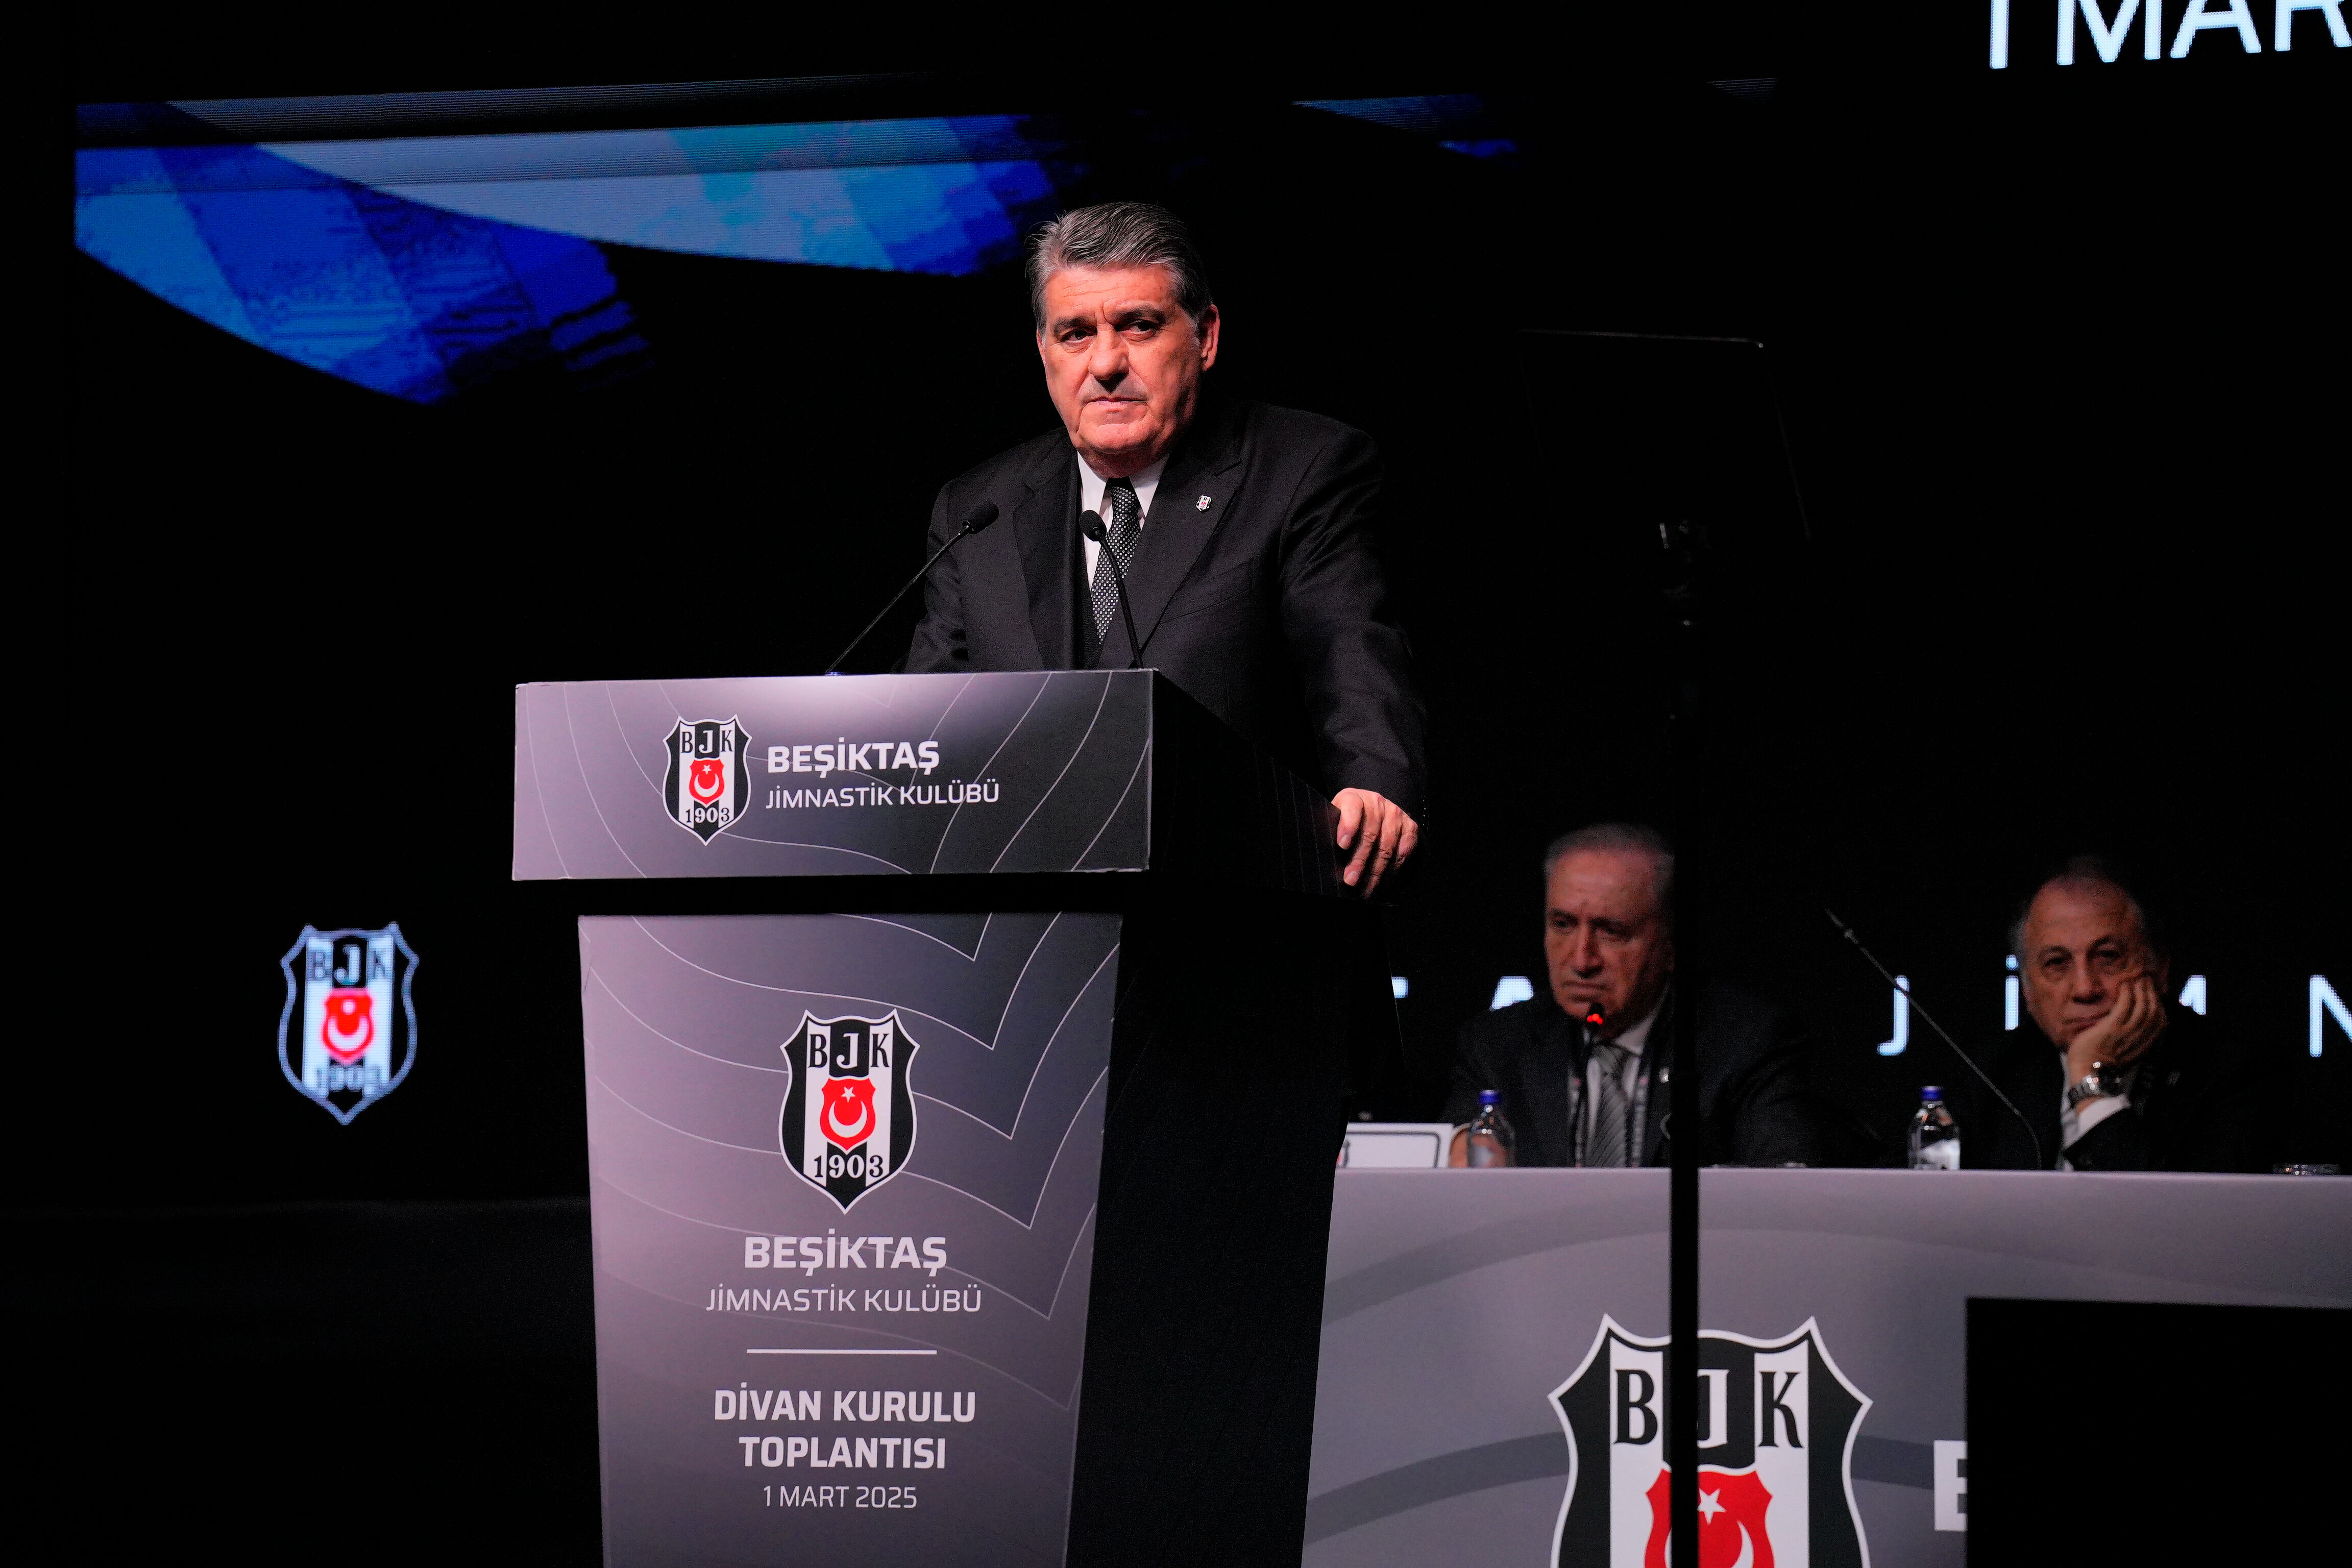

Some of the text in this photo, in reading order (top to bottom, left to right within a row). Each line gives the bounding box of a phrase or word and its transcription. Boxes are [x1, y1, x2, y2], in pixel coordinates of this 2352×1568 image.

[680, 729, 733, 754] BJK
[767, 737, 940, 778] BEŞİKTAŞ
[765, 778, 999, 809] JİMNASTİK KULÜBÜ
[685, 806, 730, 823] 1903
[808, 1032, 890, 1069] BJK
[813, 1154, 884, 1179] 1903
[744, 1228, 947, 1277] BEŞİKTAŞ
[705, 1283, 982, 1312] JİMNASTİK KULÜBÜ
[714, 1381, 976, 1423] DİVAN KURULU
[1612, 1368, 1804, 1449] BJK
[738, 1436, 946, 1469] TOPLANTISI
[763, 1485, 917, 1508] 1 MART 2025
